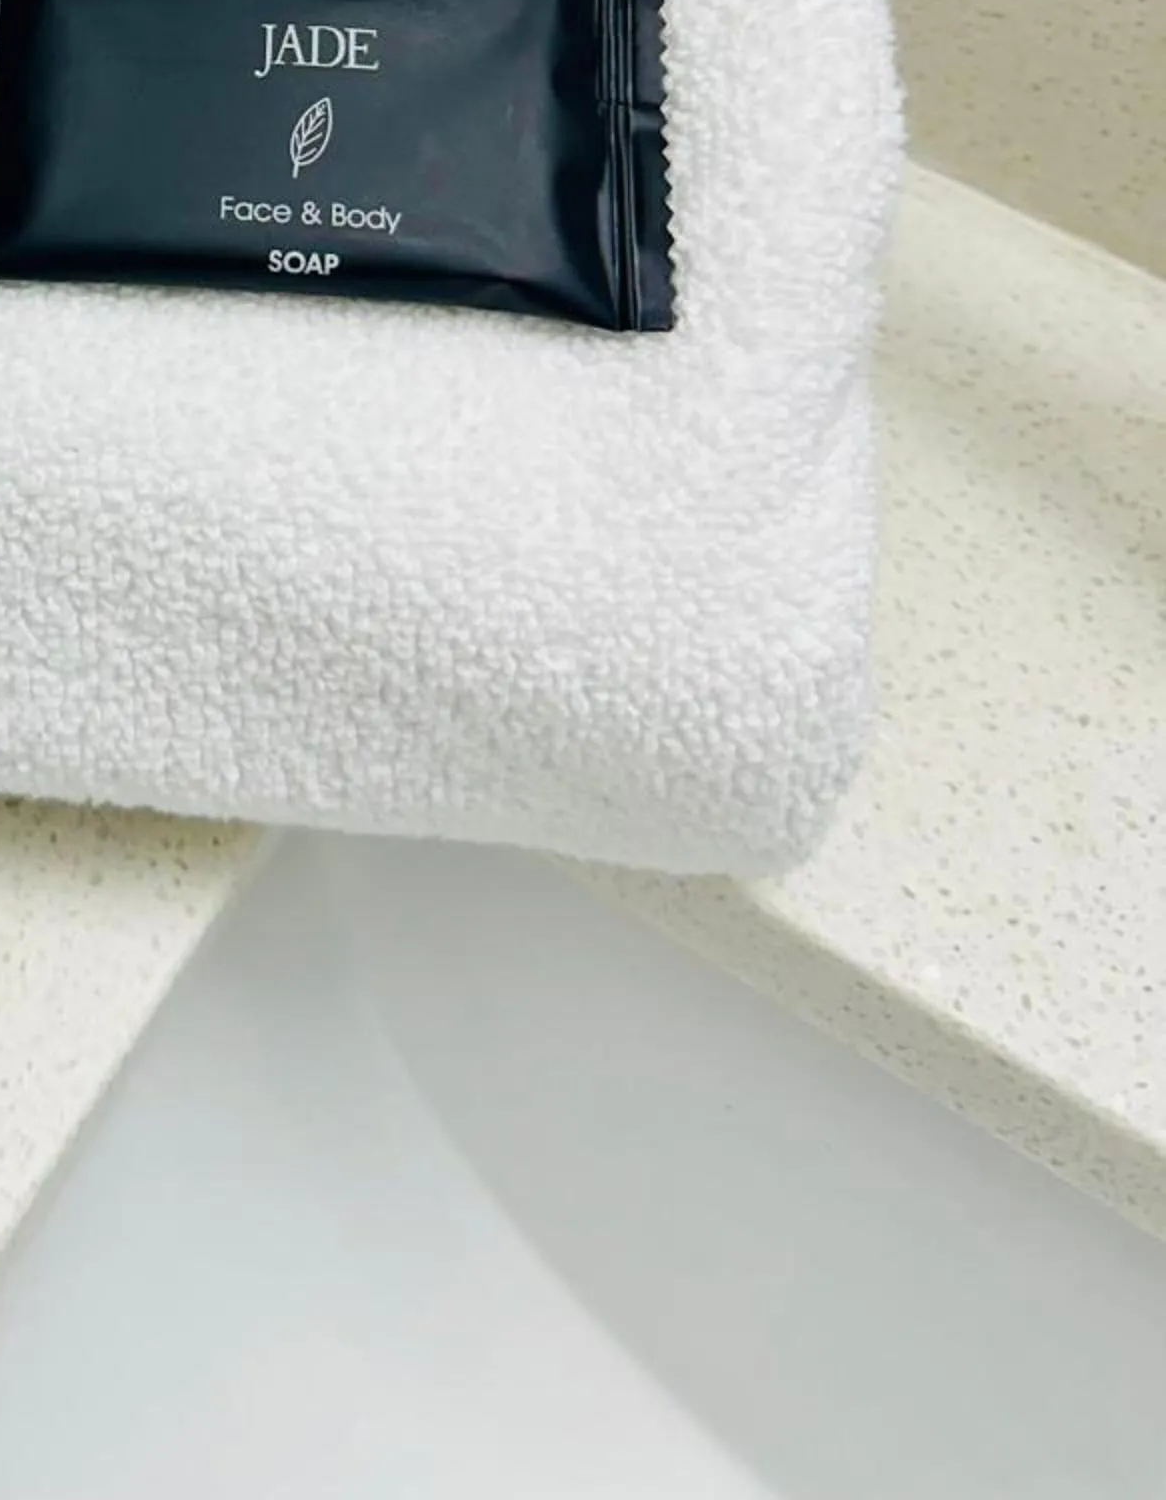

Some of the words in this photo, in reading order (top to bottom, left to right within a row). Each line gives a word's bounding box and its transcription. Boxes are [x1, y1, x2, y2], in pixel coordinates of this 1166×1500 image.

[254, 23, 380, 78] JADE
[220, 196, 291, 223] Face
[301, 201, 322, 225] &
[331, 203, 402, 235] Body
[268, 249, 340, 275] SOAP
